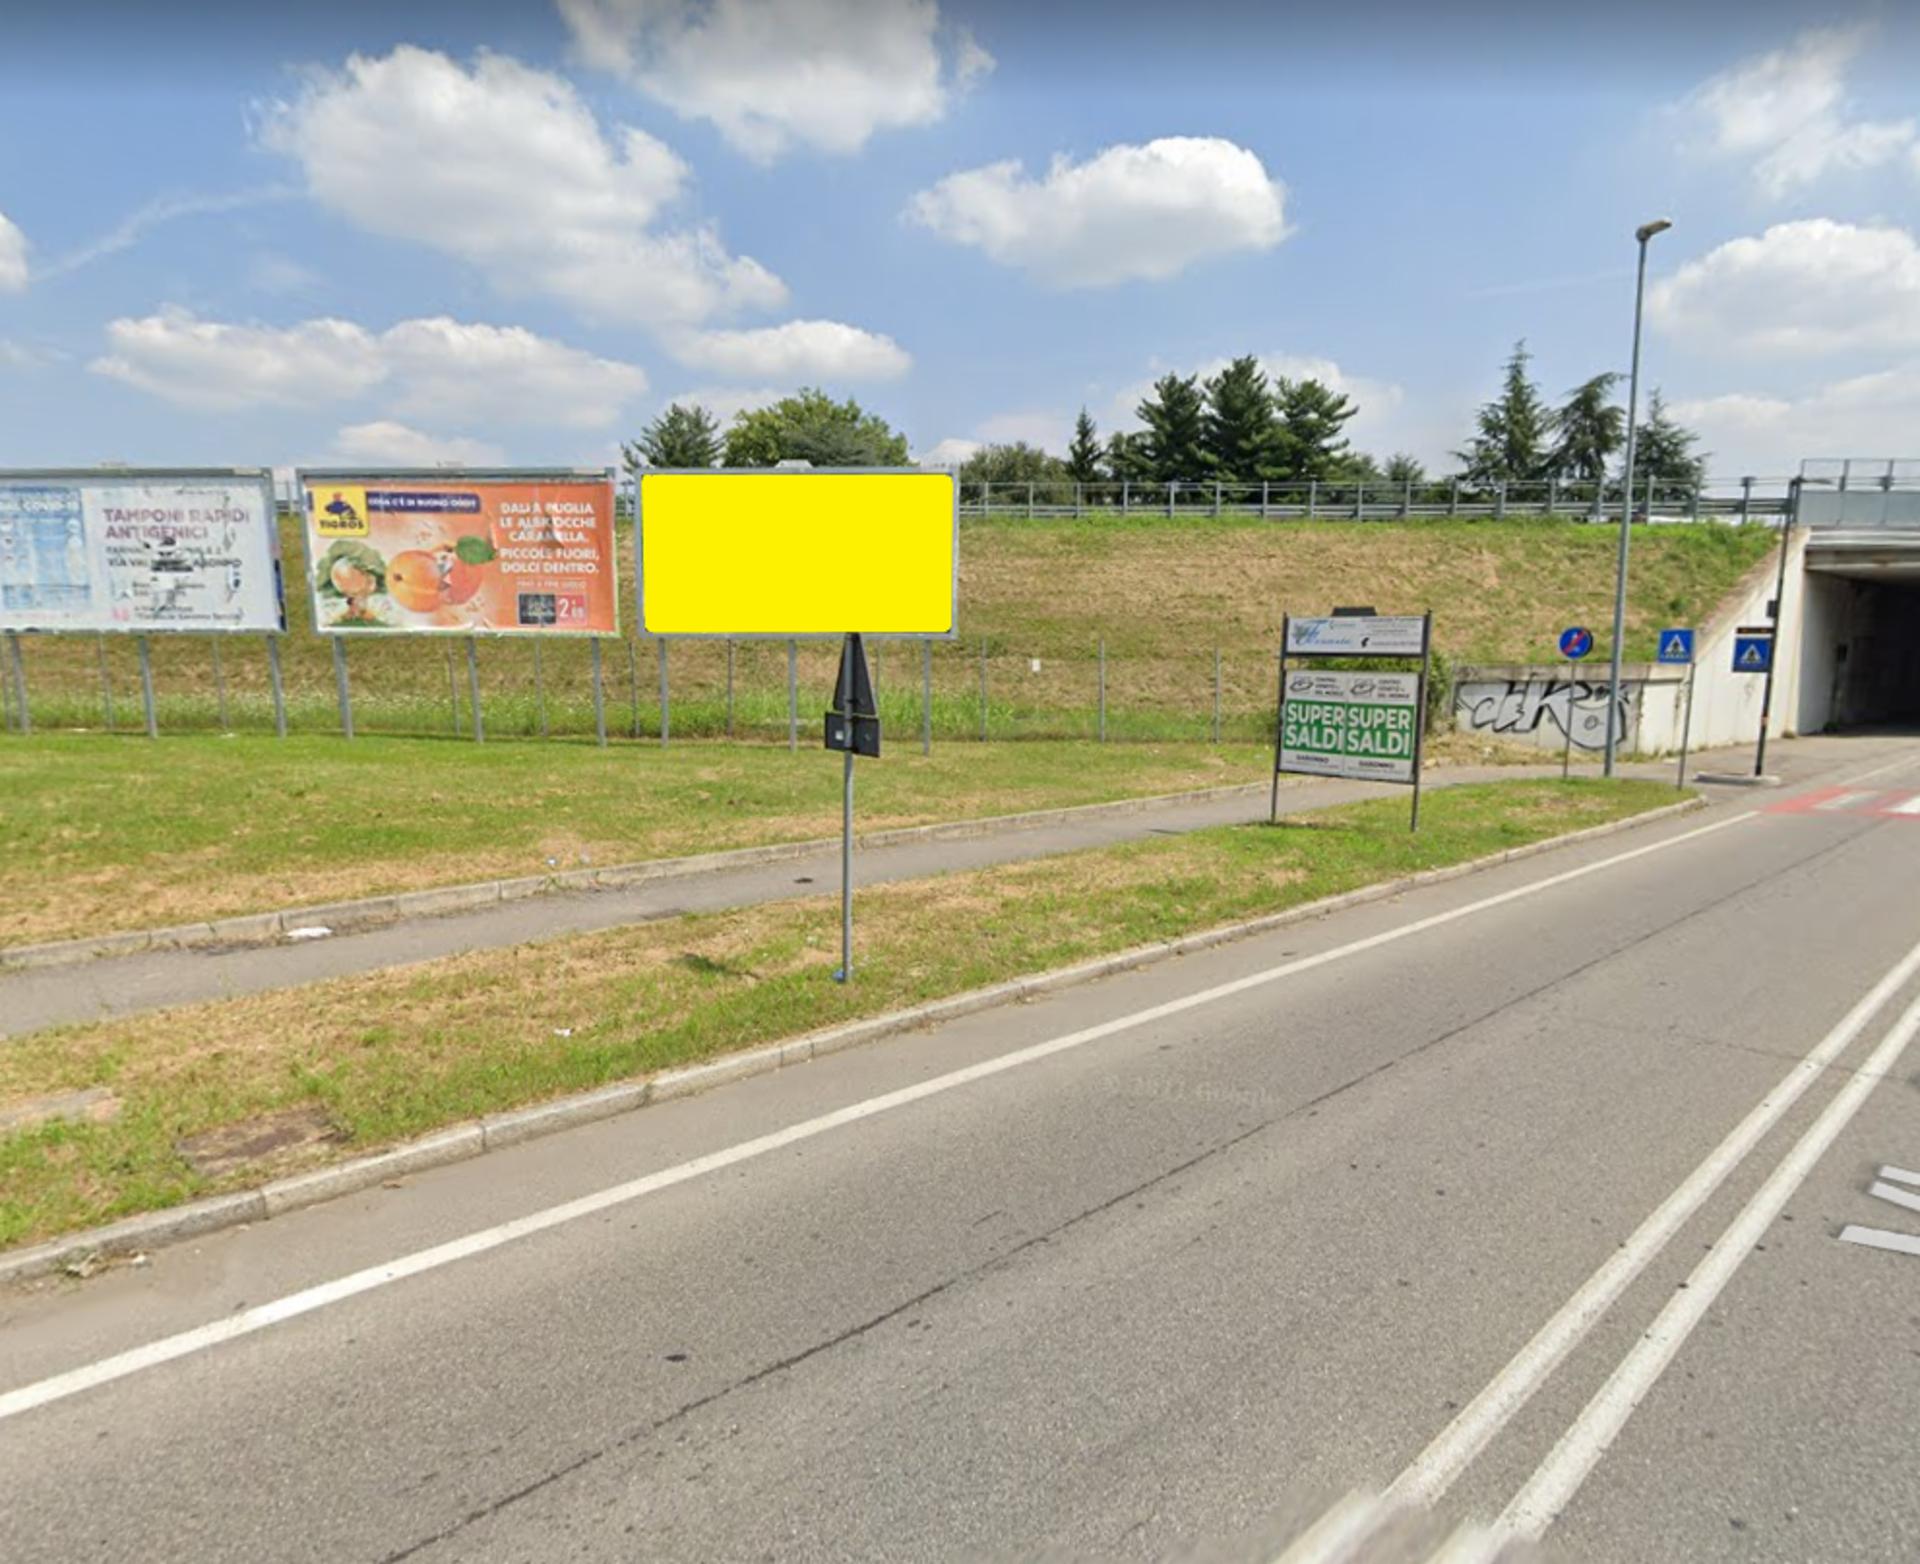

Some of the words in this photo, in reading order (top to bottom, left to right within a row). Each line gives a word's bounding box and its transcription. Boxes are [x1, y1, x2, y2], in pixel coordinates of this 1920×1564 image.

[103, 508, 184, 523] TAMPONI
[188, 508, 251, 523] RAPIDI
[500, 502, 542, 514] DALLA
[545, 502, 594, 514] PUGLIA
[319, 519, 364, 530] TIGROS
[105, 525, 209, 540] ANTIGENICI
[501, 562, 539, 573] DOLCI
[543, 562, 600, 574] DENTRO.
[1287, 703, 1346, 726] SUPER
[1348, 707, 1411, 730] SUPER
[1285, 724, 1343, 751] SALDI
[1346, 729, 1410, 756] SALDI
